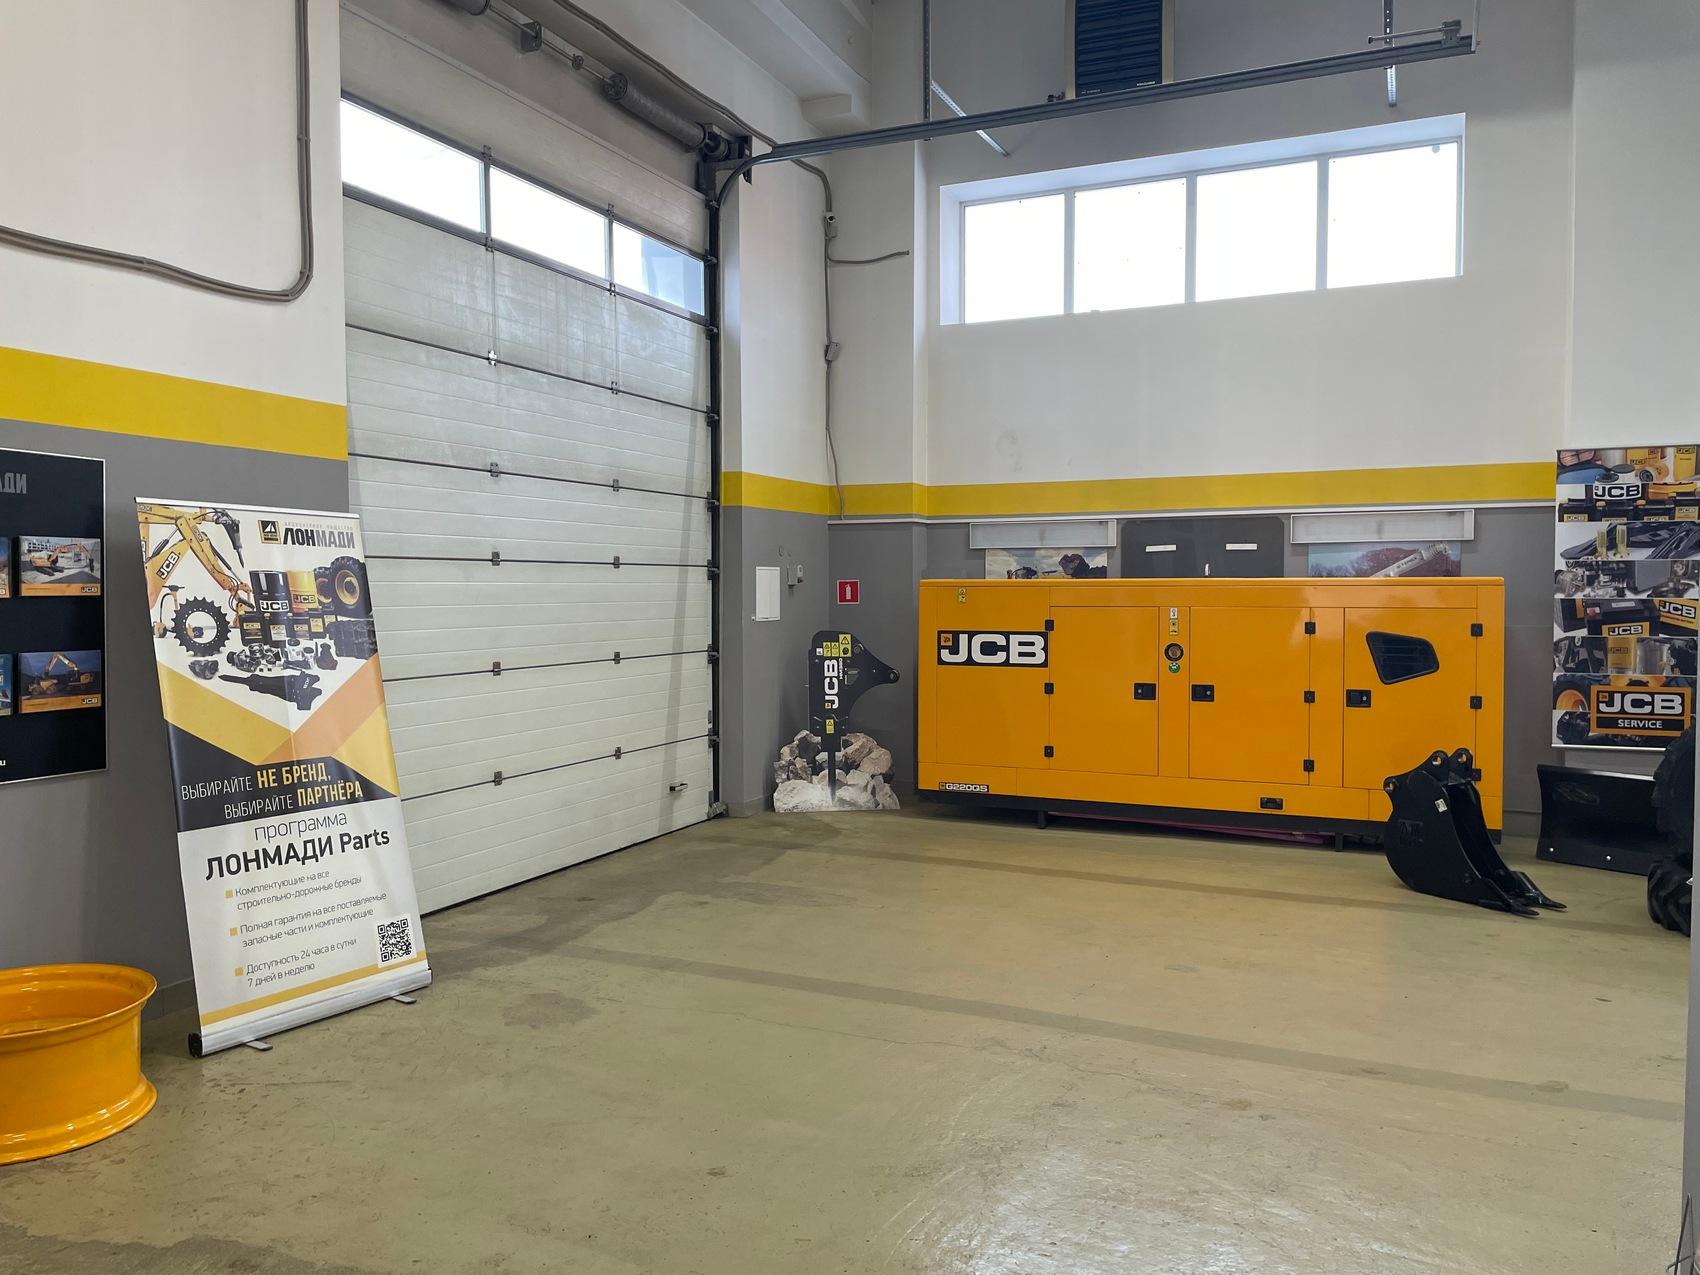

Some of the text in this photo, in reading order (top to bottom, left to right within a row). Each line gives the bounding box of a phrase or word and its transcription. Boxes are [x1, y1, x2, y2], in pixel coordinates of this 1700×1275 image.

[0, 472, 27, 494] ДИ
[1594, 484, 1641, 498] JCB
[283, 527, 355, 549] ЛОНМАДИ
[159, 552, 180, 579] JCB
[261, 601, 288, 611] JCB
[293, 595, 316, 603] JCB
[1660, 601, 1695, 618] JCB
[1610, 625, 1642, 636] JCB
[940, 633, 1046, 664] JCB
[824, 659, 839, 709] JCB
[1599, 693, 1683, 714] JCB
[1617, 719, 1663, 729] SERVICE
[181, 762, 331, 800] ВЫБИРАЙТЕ НЕ БРЕНД,
[224, 780, 363, 819] ВЫБИРАЙТЕ ПАРТНЁРА
[254, 812, 348, 843] программа
[206, 829, 390, 881] ЛОНМАДИ Parts
[235, 870, 330, 897] Комплектующие на все
[237, 876, 362, 911] строительно-дорожные бренды
[240, 892, 387, 934] Полная гарантия на все поставляемые
[242, 930, 283, 948] запасные
[284, 924, 307, 937] части
[315, 908, 374, 930] комплектующие
[246, 954, 300, 976] Доступность
[300, 949, 311, 960] 24
[311, 945, 330, 956] часа
[336, 938, 357, 953] сутки
[247, 977, 254, 988] 7
[254, 973, 277, 987] дней
[284, 962, 316, 977] неделю
